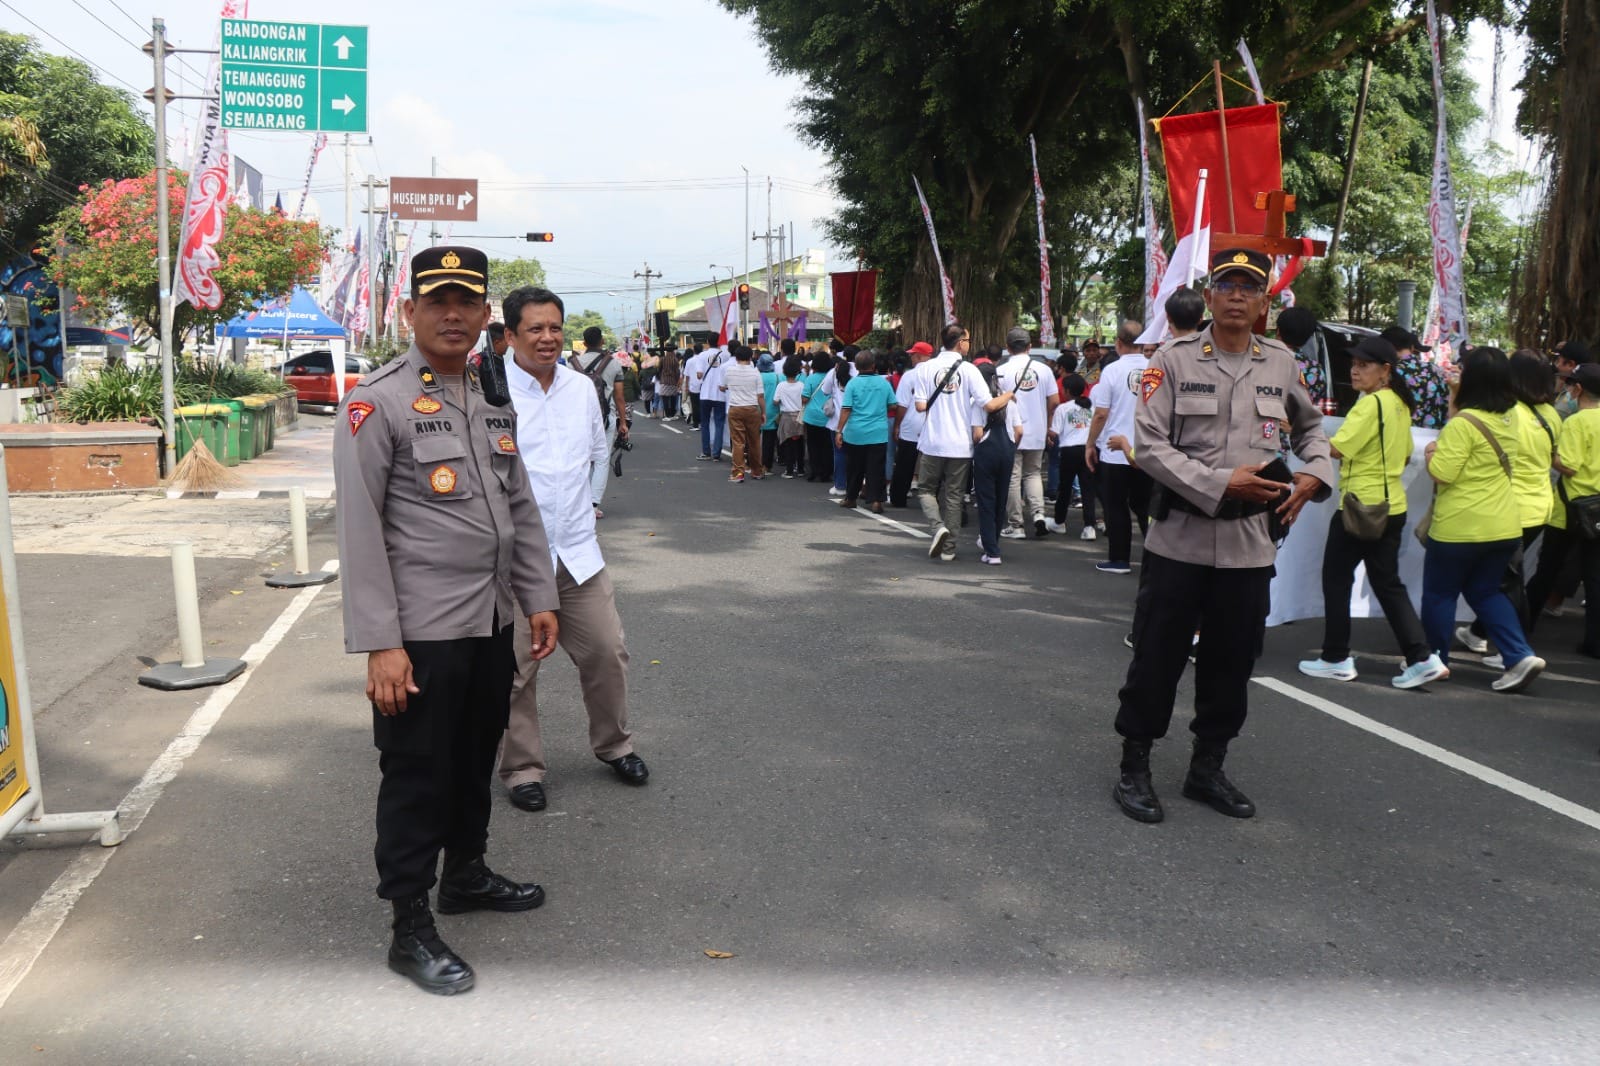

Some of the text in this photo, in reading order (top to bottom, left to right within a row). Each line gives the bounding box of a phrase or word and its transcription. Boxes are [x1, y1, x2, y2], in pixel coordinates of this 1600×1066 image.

[224, 22, 306, 41] BANDONGAN
[224, 44, 307, 63] KALIANGKRIK
[224, 71, 306, 89] TEMANGGUNG
[224, 91, 304, 109] WONOSOBO
[224, 111, 306, 130] SEMARANG
[392, 192, 455, 206] MUSEUM BPK RI
[1255, 385, 1283, 397] POLRI
[415, 420, 453, 434] RINTO
